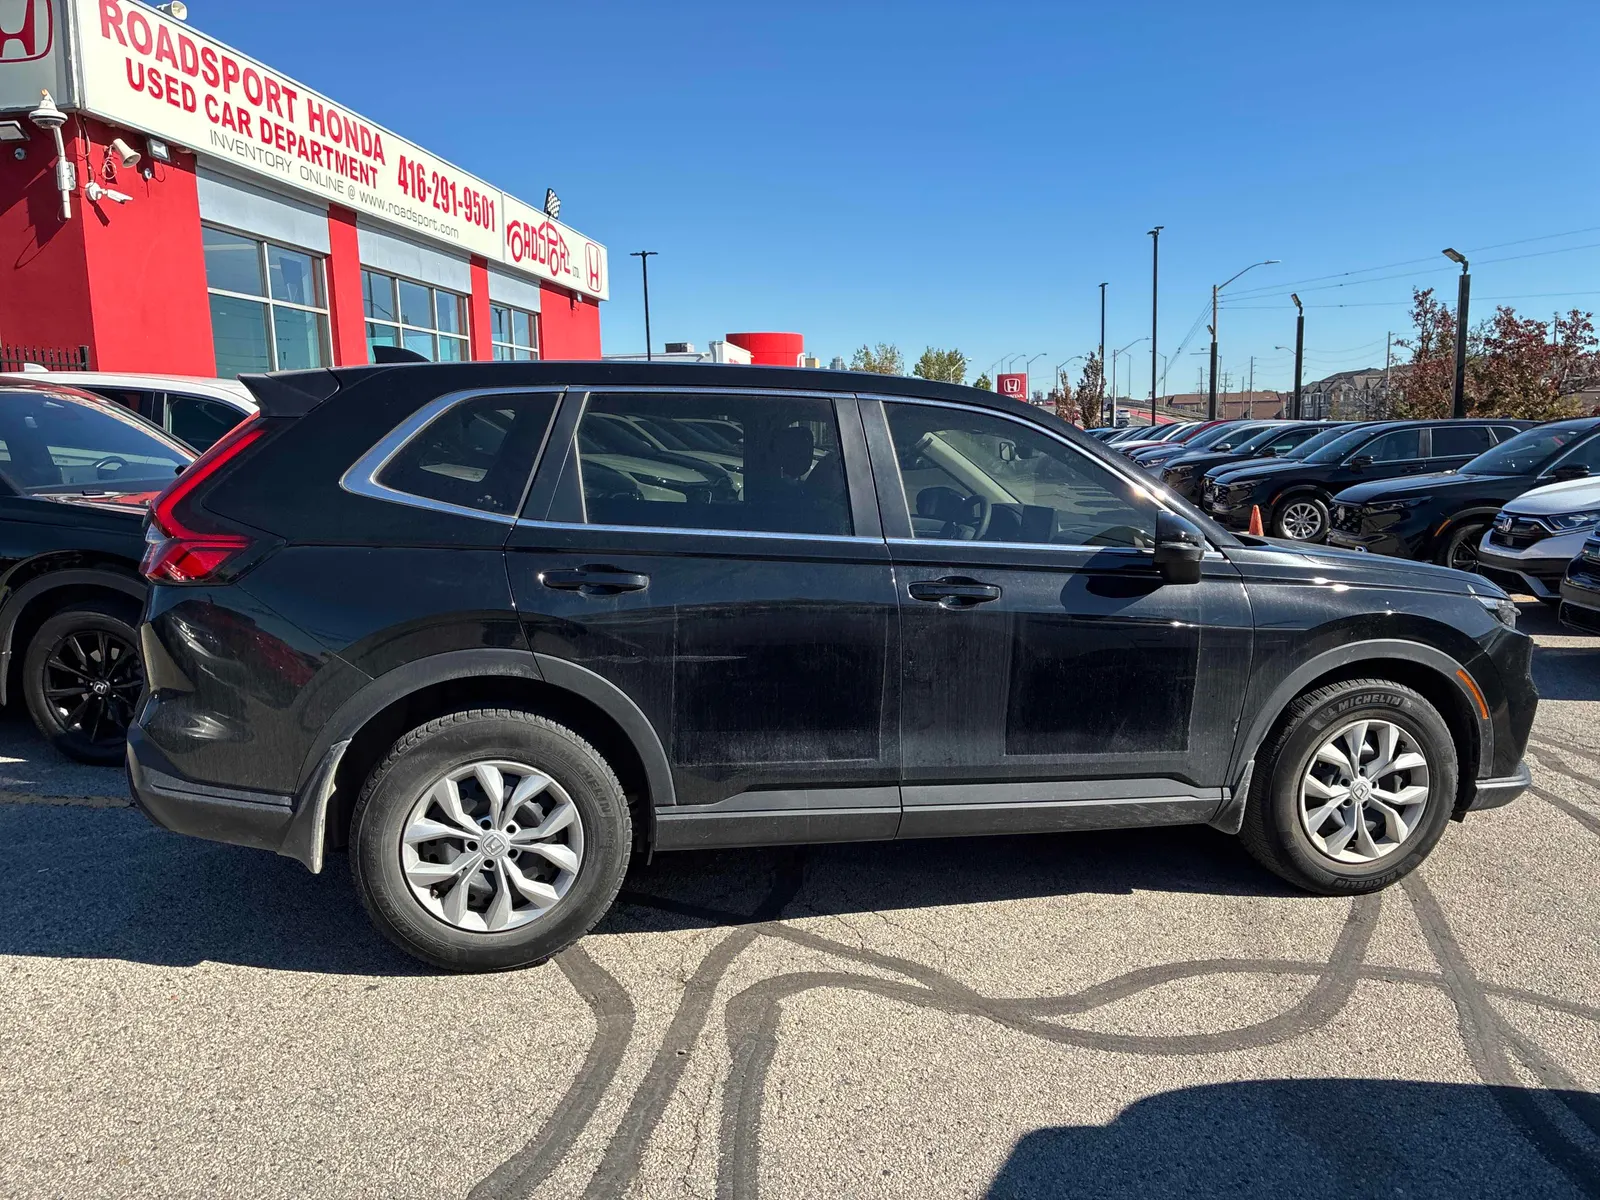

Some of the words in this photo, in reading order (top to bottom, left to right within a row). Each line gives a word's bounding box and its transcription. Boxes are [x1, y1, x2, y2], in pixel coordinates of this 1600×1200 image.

[99, 0, 297, 123] ROADSPORT
[307, 98, 386, 166] HONDA
[125, 57, 197, 113] USED
[204, 94, 254, 139] CAR
[260, 116, 379, 189] DEPARTMENT
[210, 129, 292, 173] INVENTORY
[300, 165, 344, 194] ONLINE
[347, 184, 356, 200] @
[359, 190, 460, 239] www.roadsport.com
[398, 154, 495, 233] 416-291-9501
[1338, 694, 1402, 711] MICHELIN
[1334, 871, 1398, 889] MICHELIN
